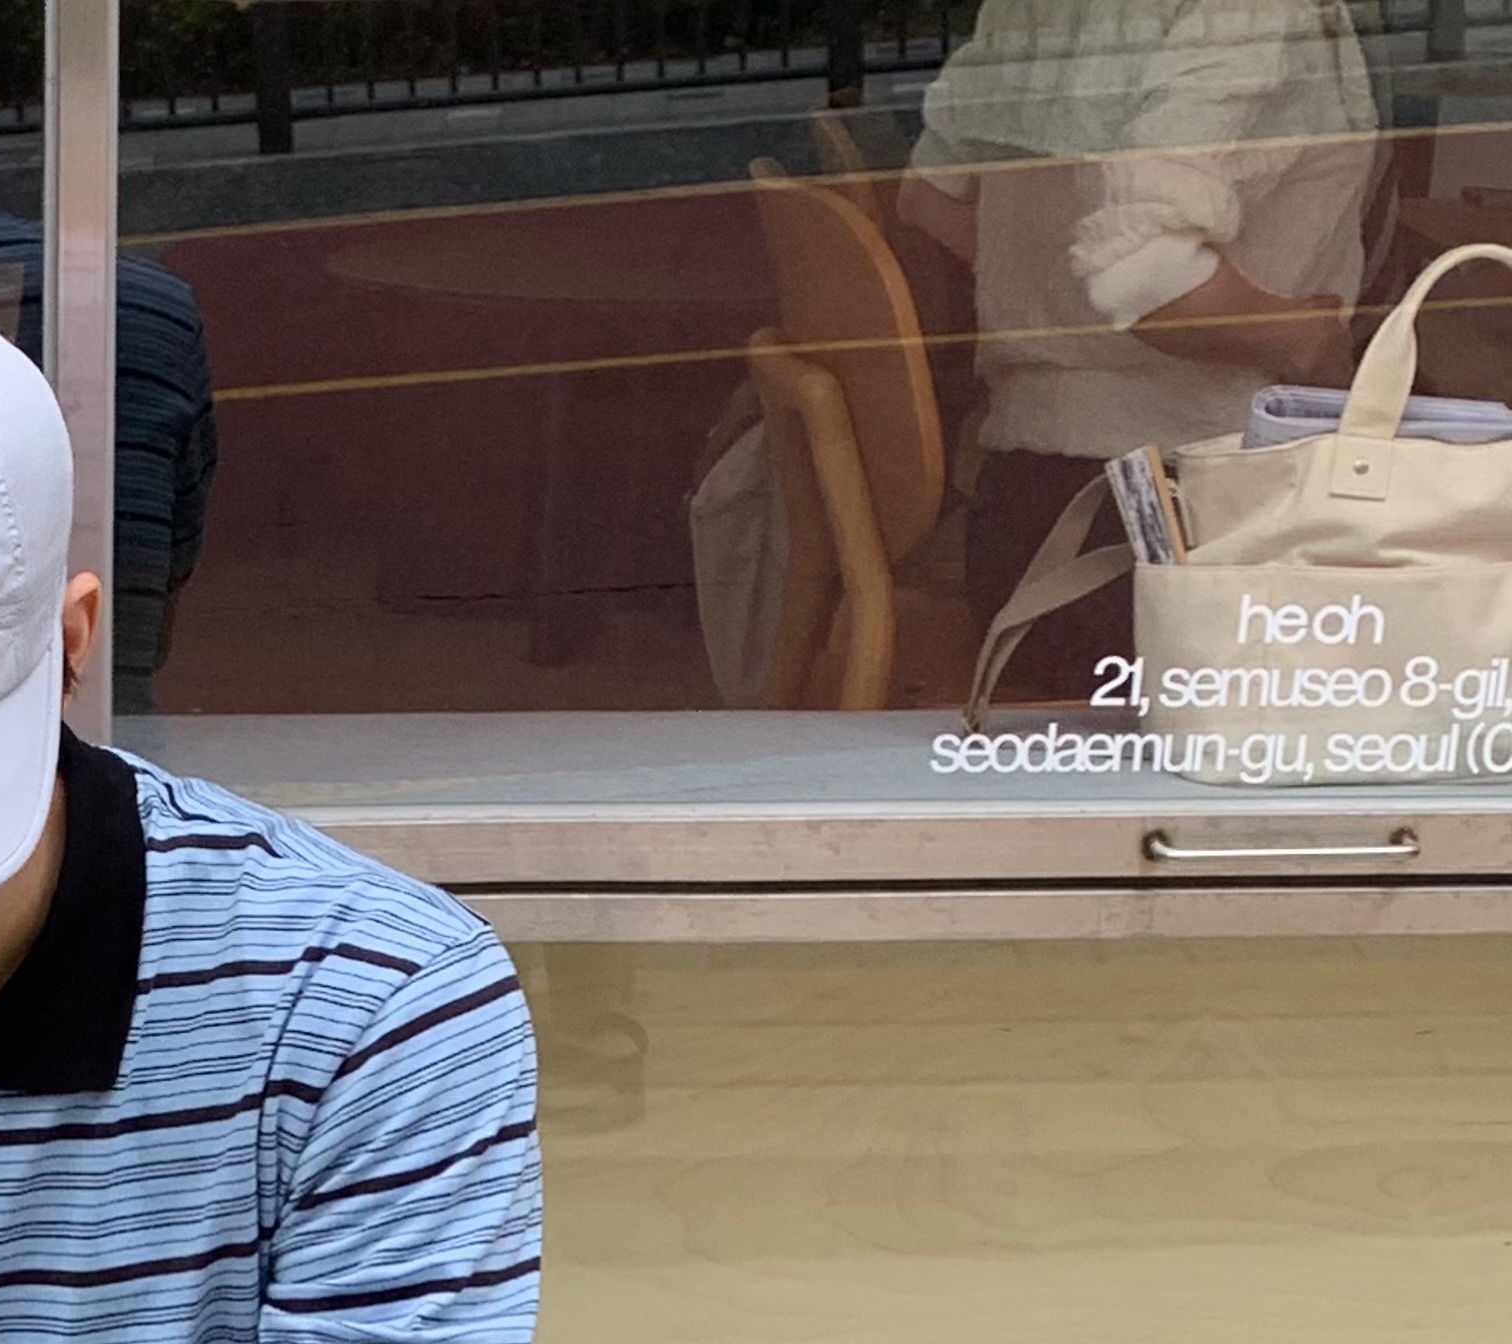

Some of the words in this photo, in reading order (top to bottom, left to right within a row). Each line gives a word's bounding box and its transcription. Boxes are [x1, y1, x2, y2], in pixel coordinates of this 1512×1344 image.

[1090, 656, 1150, 716] 21,
[1160, 667, 1393, 707] semuseo
[931, 723, 1313, 784] seodaemun-gu,
[1323, 722, 1459, 774] seoul
